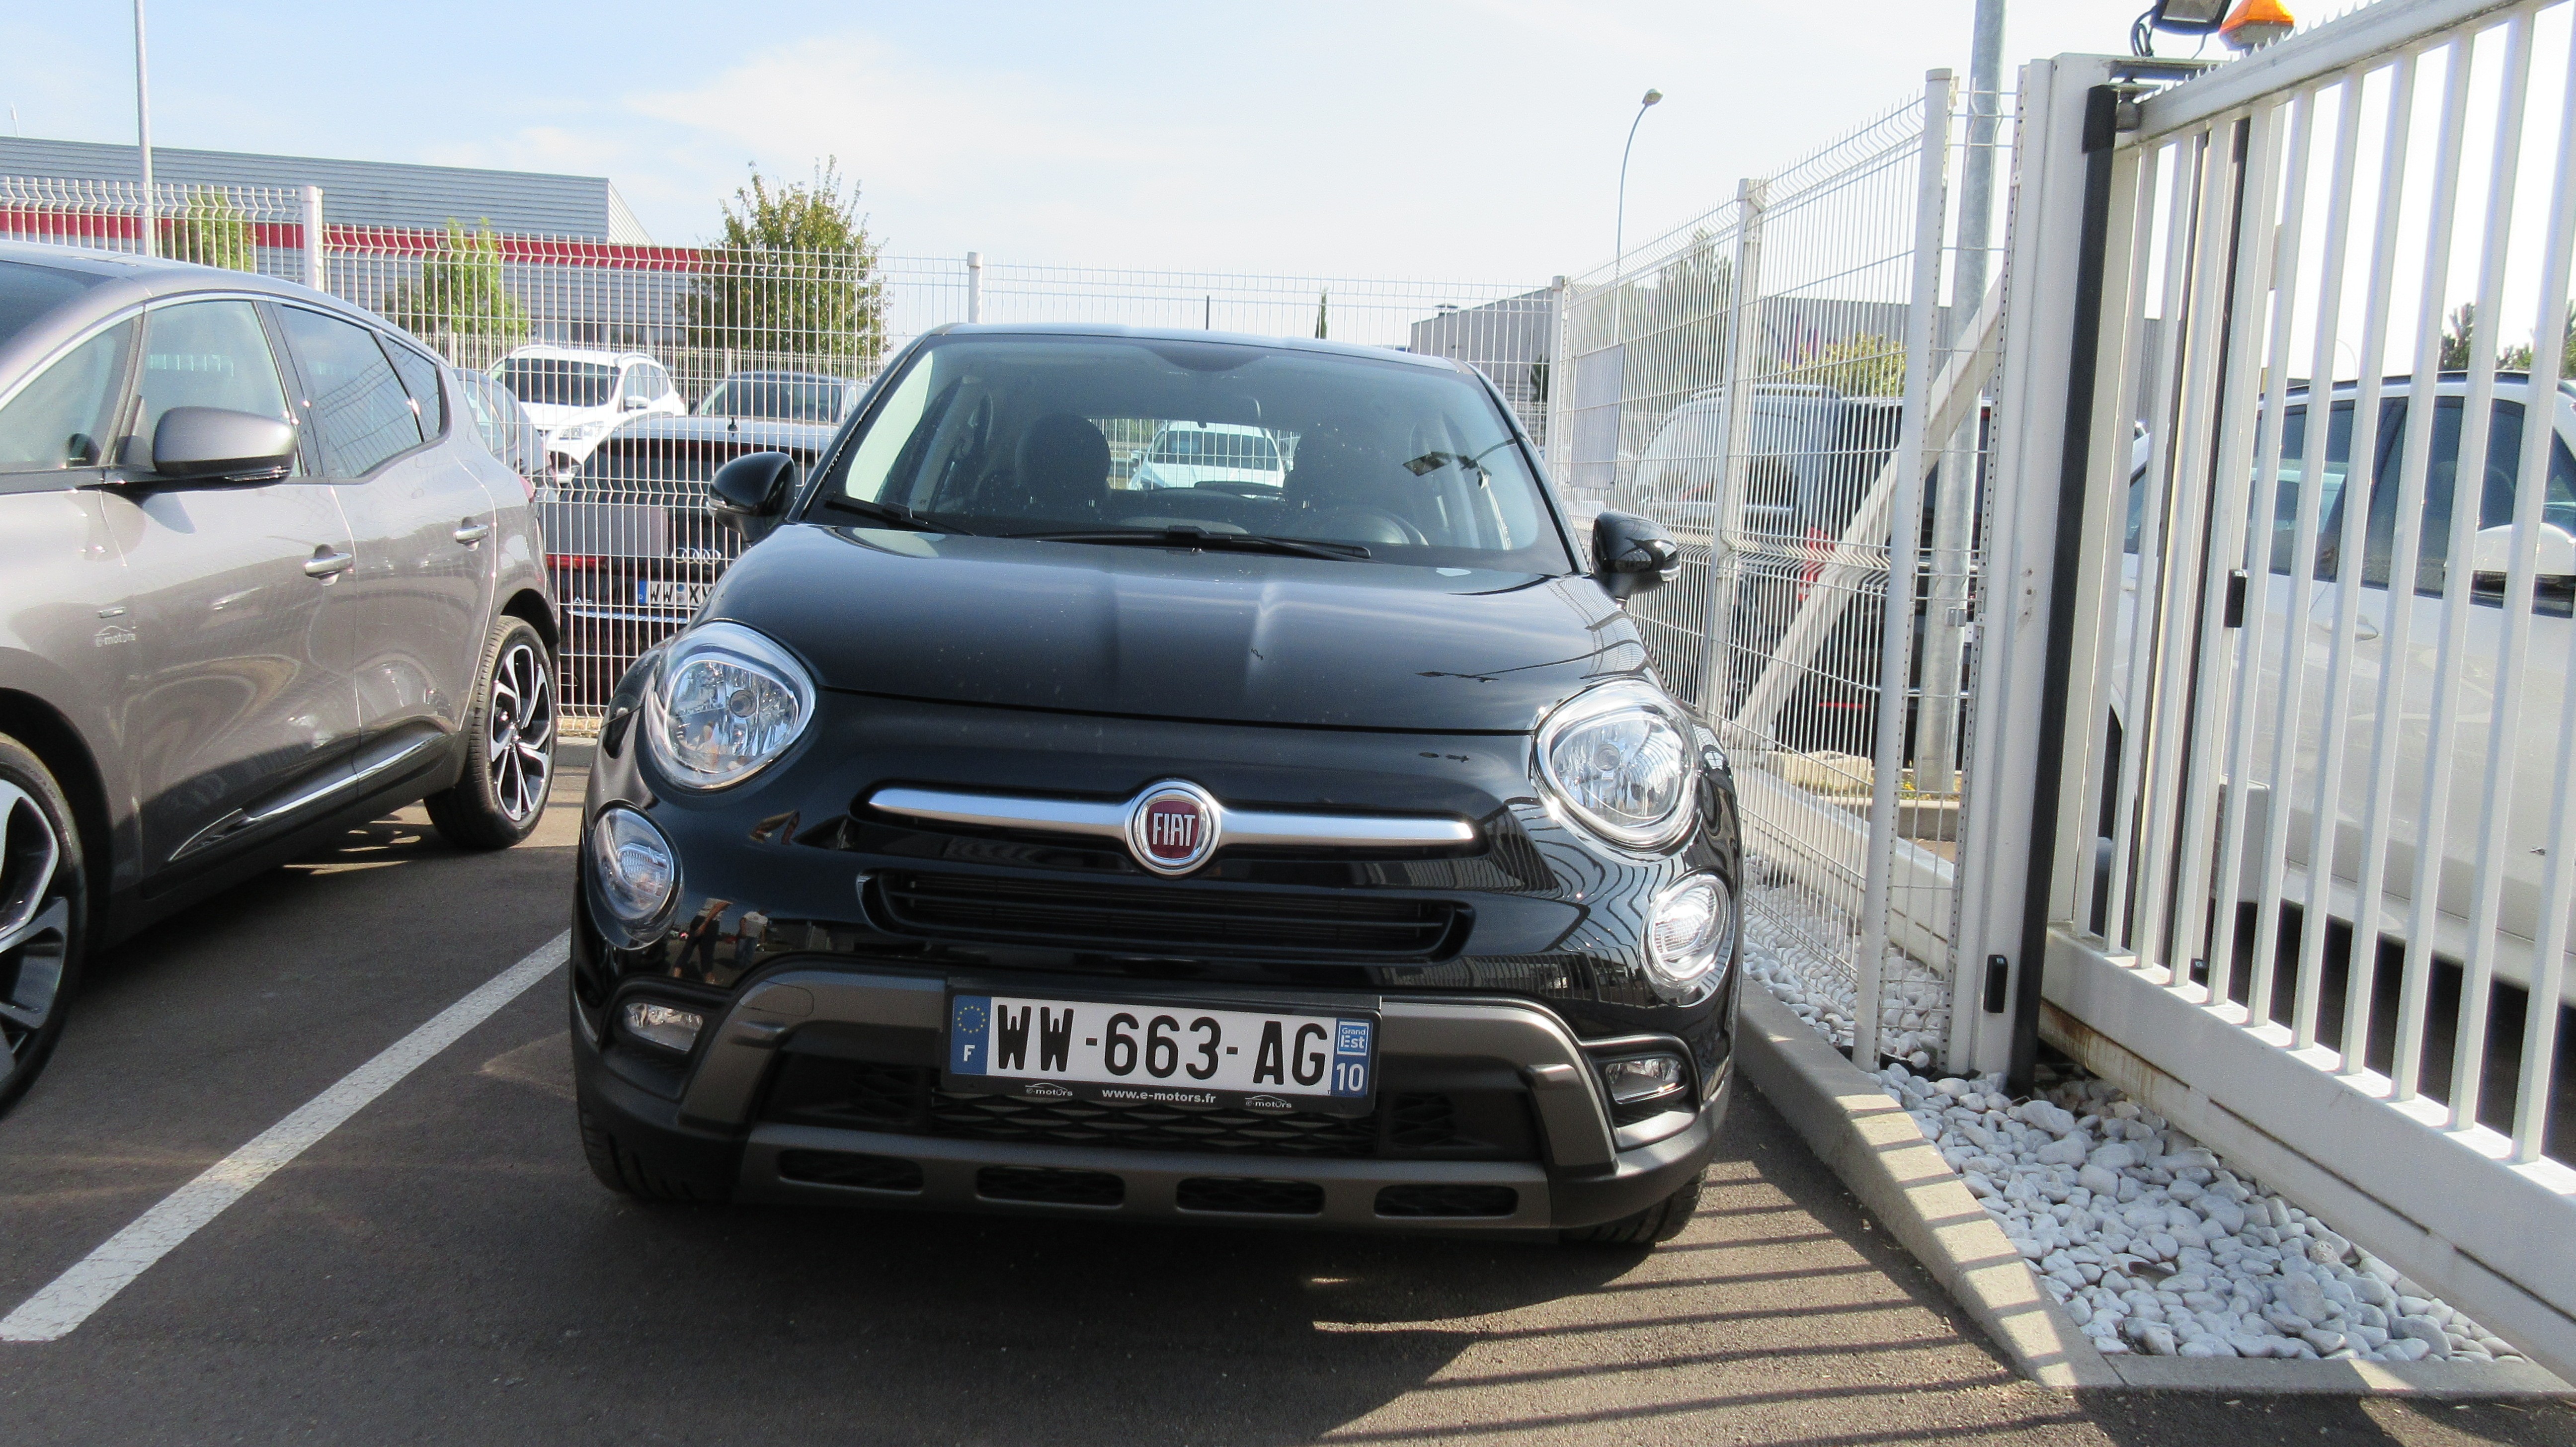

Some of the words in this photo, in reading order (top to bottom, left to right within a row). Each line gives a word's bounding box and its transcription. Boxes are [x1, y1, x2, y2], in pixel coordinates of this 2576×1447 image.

[1152, 812, 1196, 847] FIAT
[1342, 1027, 1366, 1036] Grand
[997, 1004, 1328, 1086] WW-663-AG
[1340, 1035, 1365, 1048] Est
[964, 1044, 975, 1062] F
[1336, 1062, 1365, 1092] 10
[1102, 1089, 1216, 1104] www.e-motors.fr
